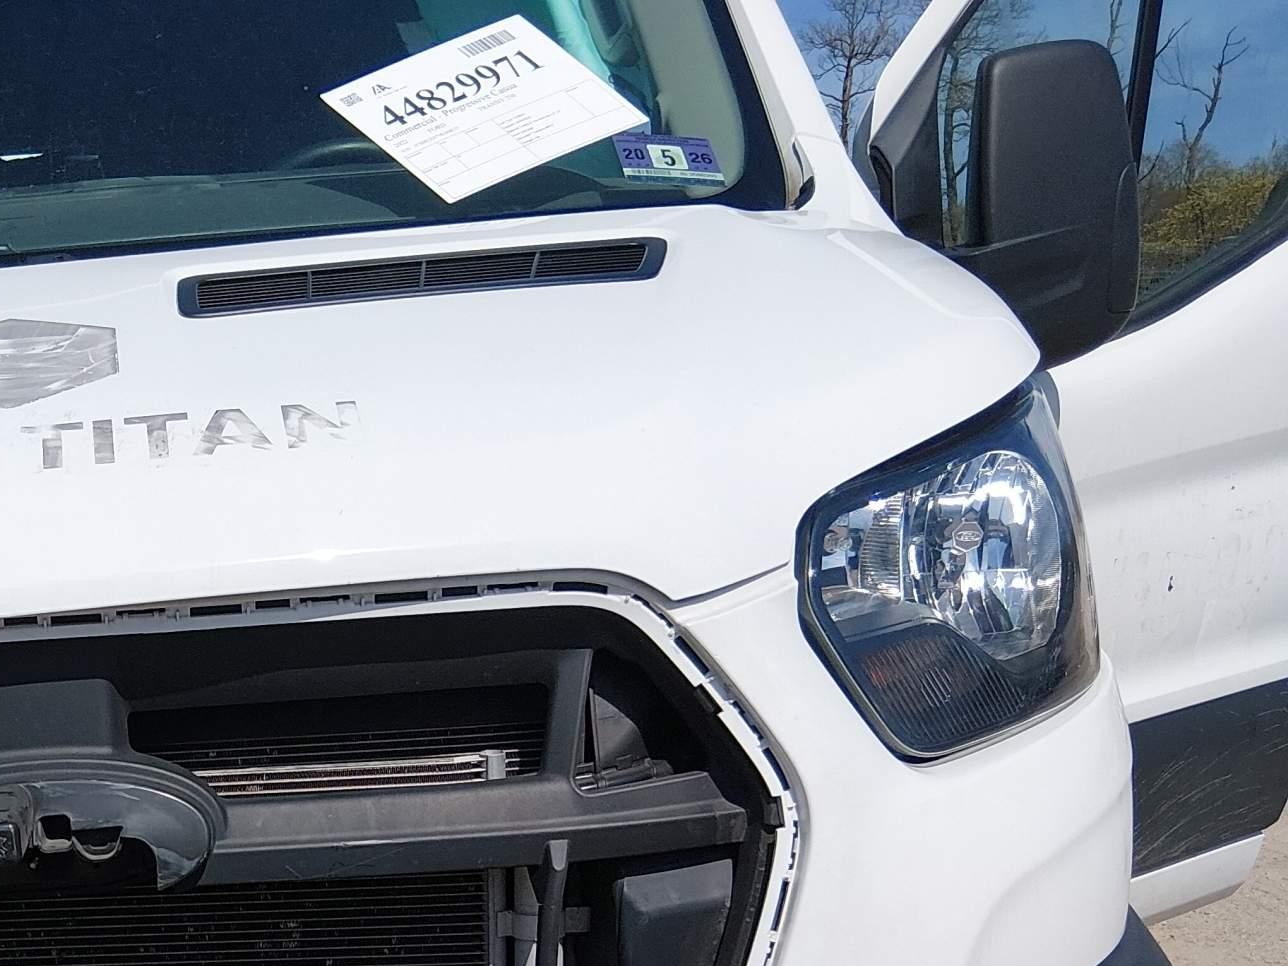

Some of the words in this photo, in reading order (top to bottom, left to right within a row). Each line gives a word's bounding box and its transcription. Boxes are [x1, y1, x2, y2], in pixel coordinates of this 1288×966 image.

[383, 50, 544, 126] 44829971
[383, 115, 438, 142] Commercial
[441, 93, 493, 118] Progressive
[622, 148, 645, 160] 20
[661, 149, 676, 166] 5
[688, 152, 713, 165] 26
[21, 401, 360, 471] TITAN
